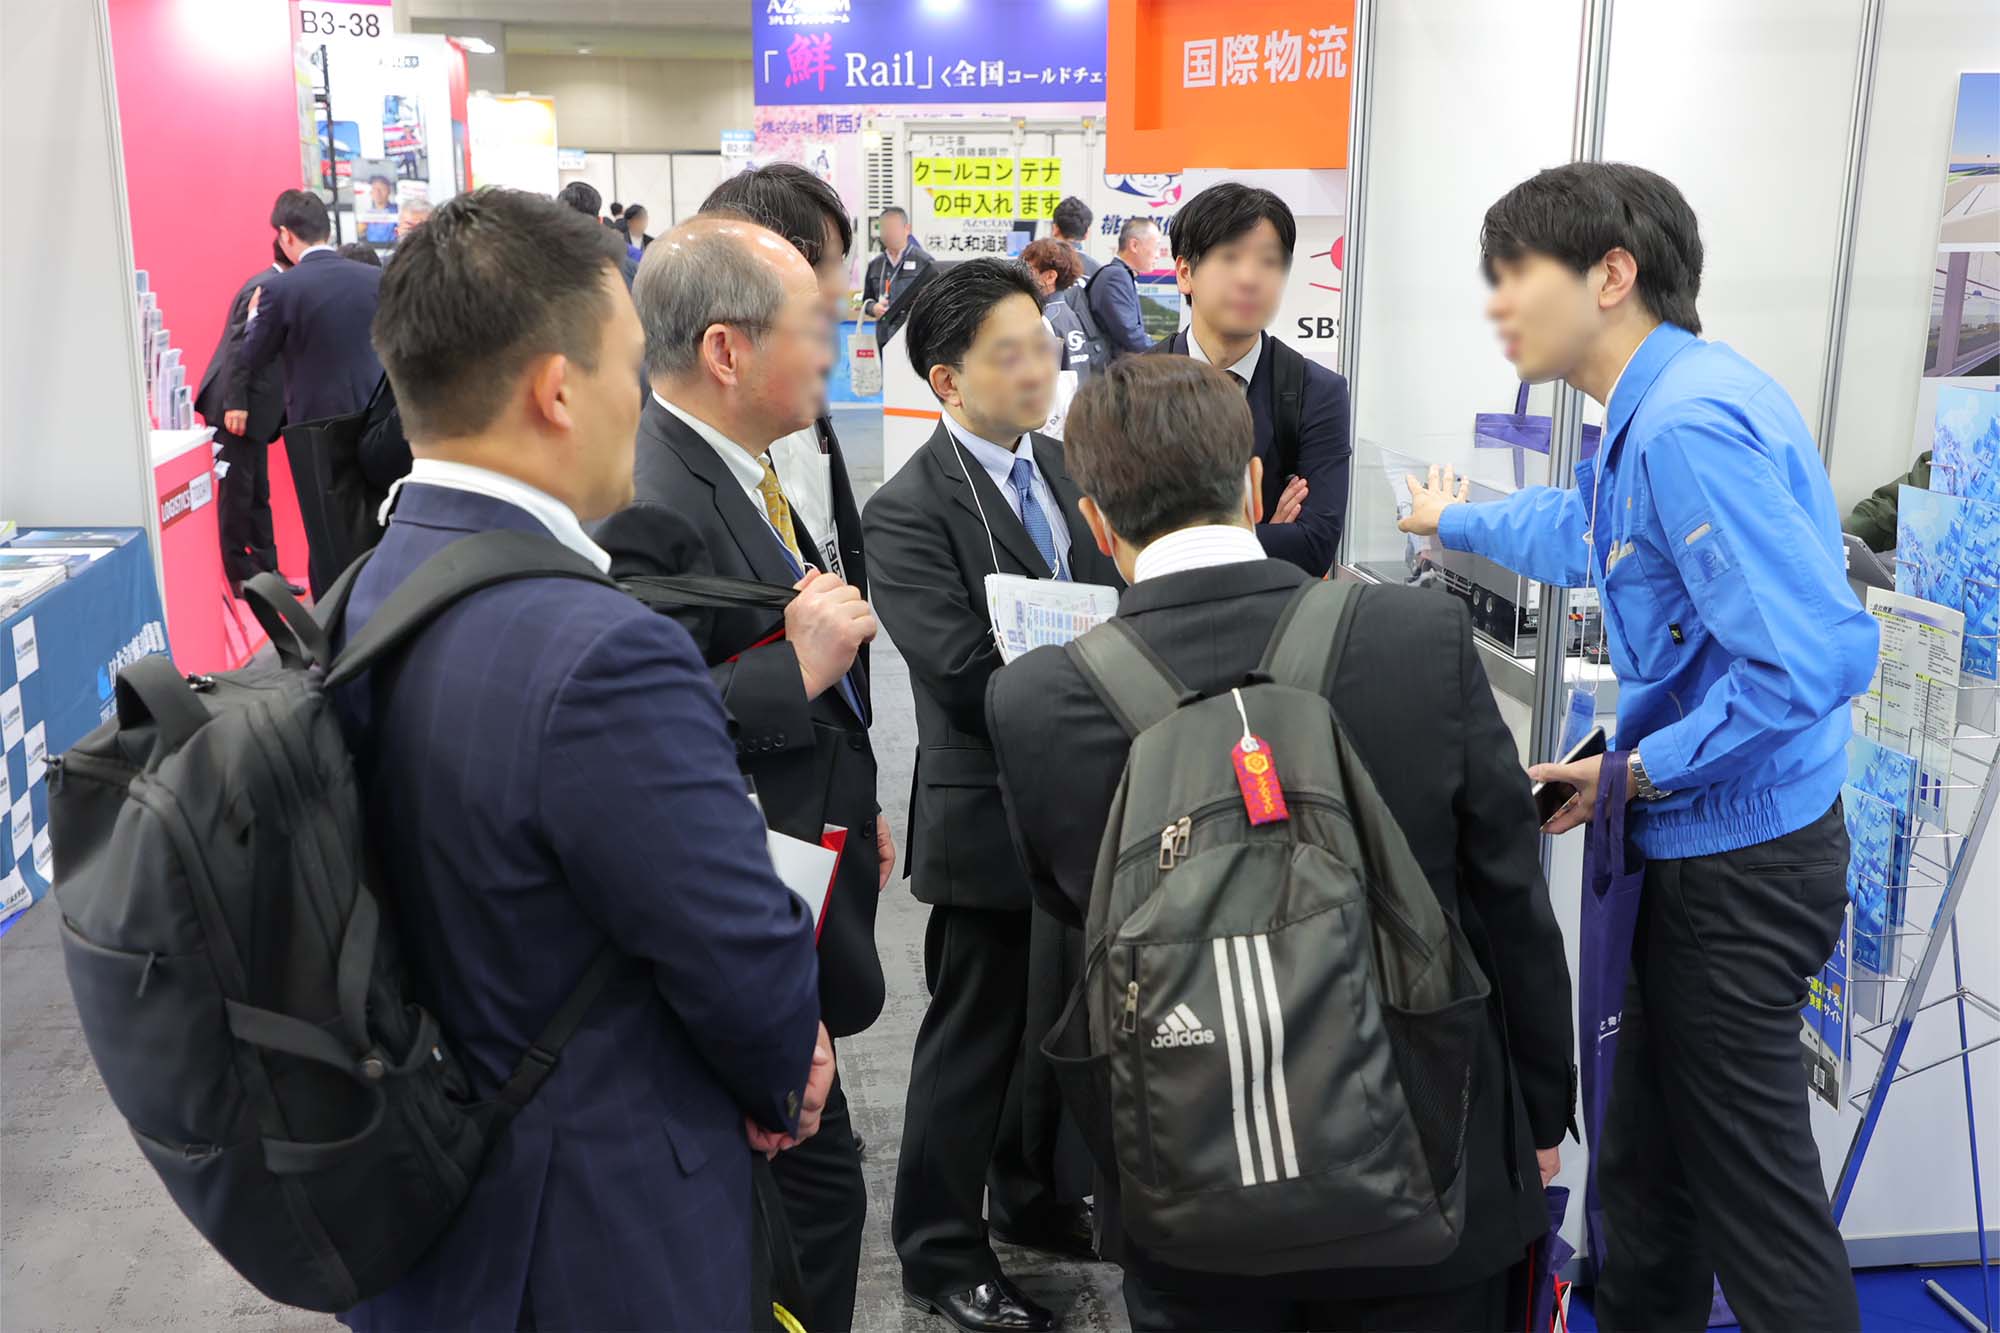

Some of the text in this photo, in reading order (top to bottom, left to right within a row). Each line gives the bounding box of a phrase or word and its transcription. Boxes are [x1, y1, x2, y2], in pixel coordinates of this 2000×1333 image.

[300, 10, 380, 38] B3-38
[1183, 24, 1348, 89] 国際物流
[915, 161, 1061, 182] クールコンテナ
[934, 193, 1060, 215] の中入れます
[1297, 316, 1340, 339] SB
[1150, 1028, 1216, 1049] adidas
